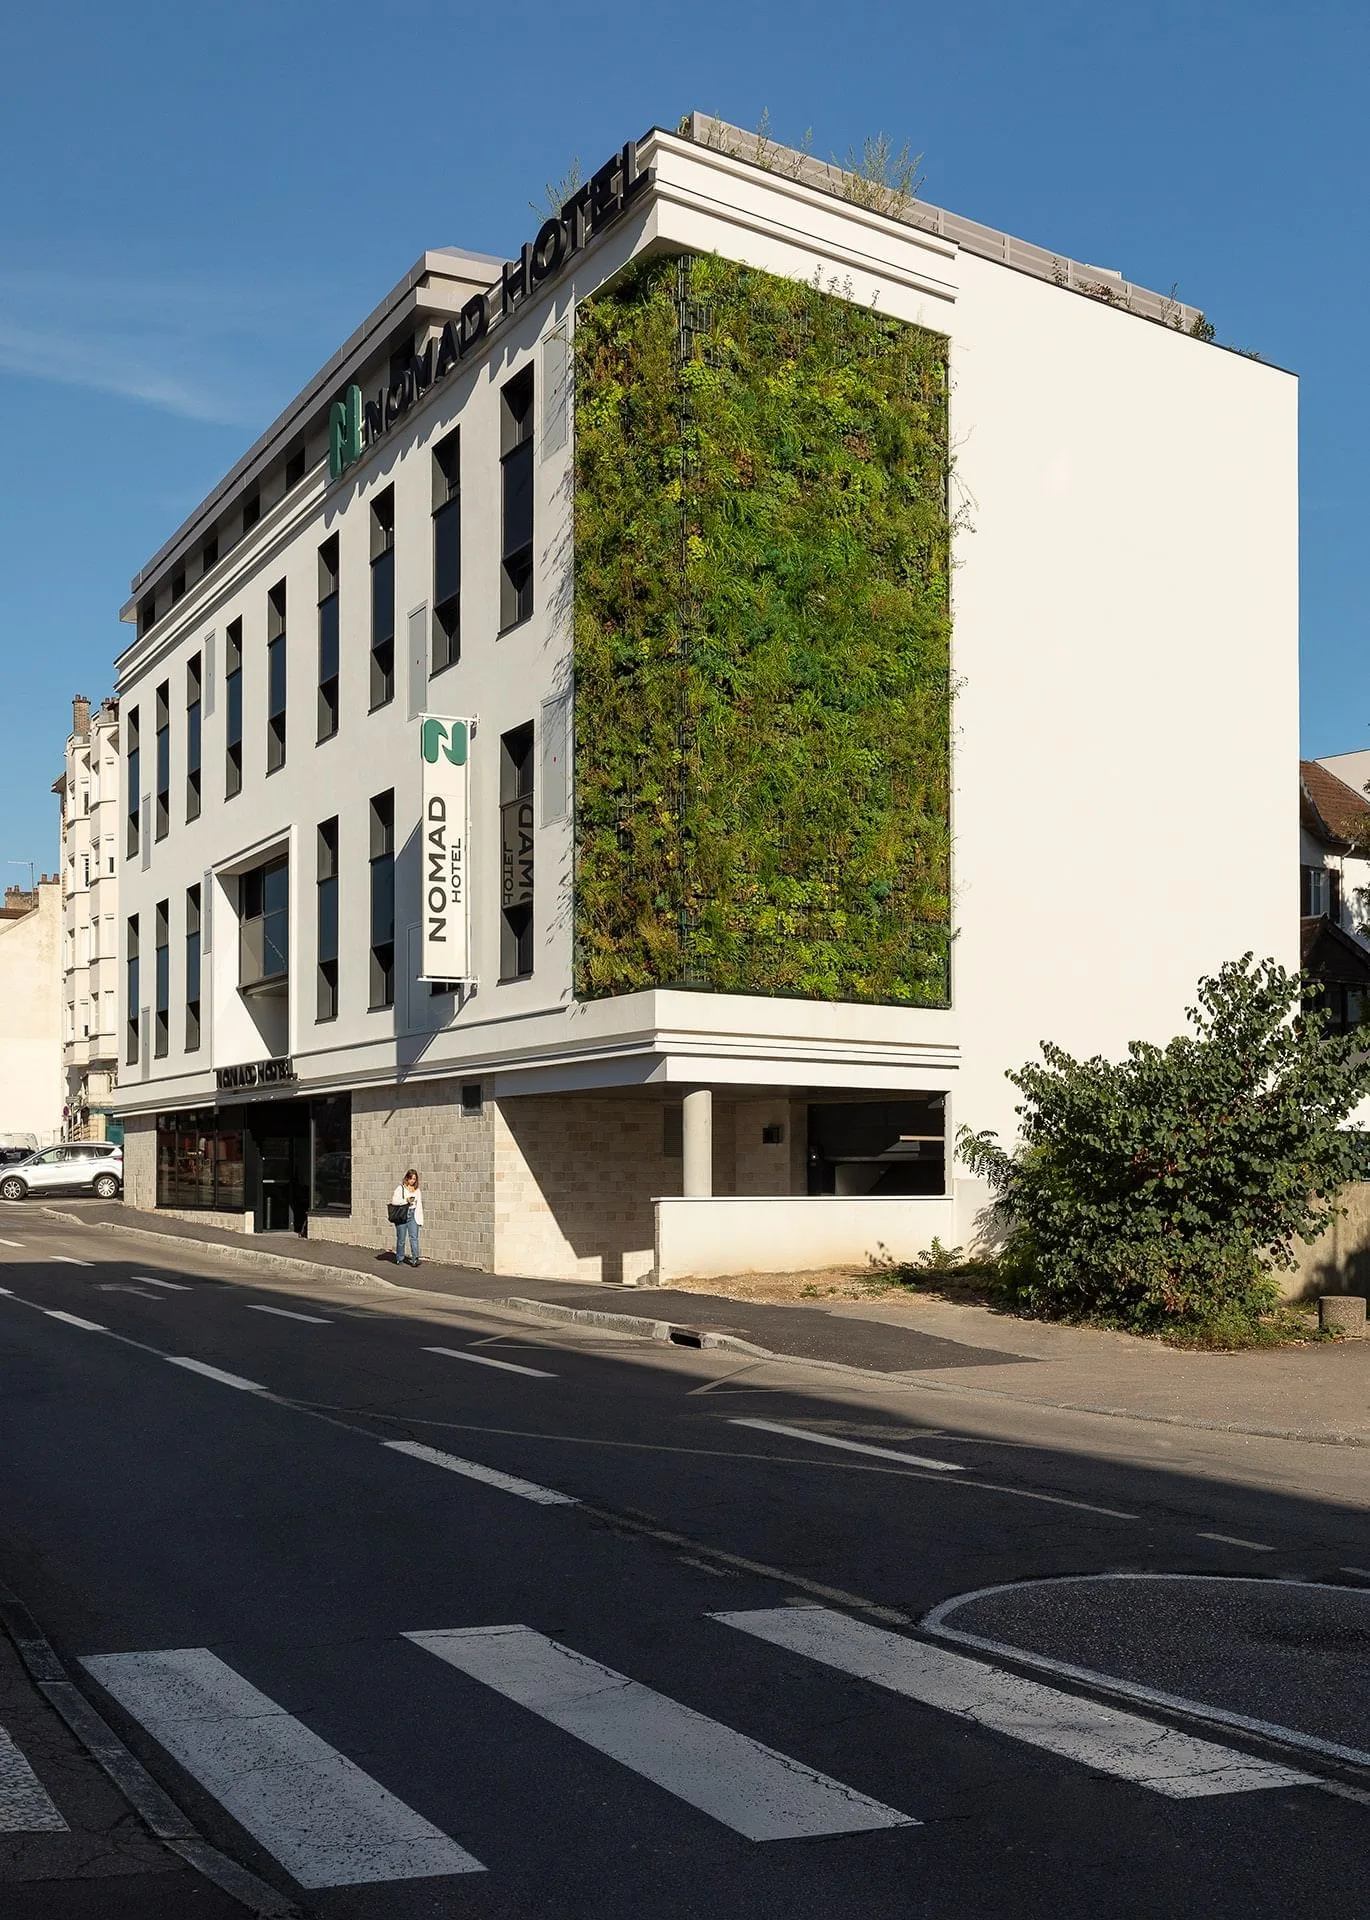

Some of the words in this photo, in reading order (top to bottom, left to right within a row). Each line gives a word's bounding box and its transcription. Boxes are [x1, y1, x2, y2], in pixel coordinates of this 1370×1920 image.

[365, 293, 489, 447] NOMAD
[502, 141, 657, 315] HOTEL
[428, 796, 447, 942] NOMAD
[451, 838, 461, 903] HOTEL
